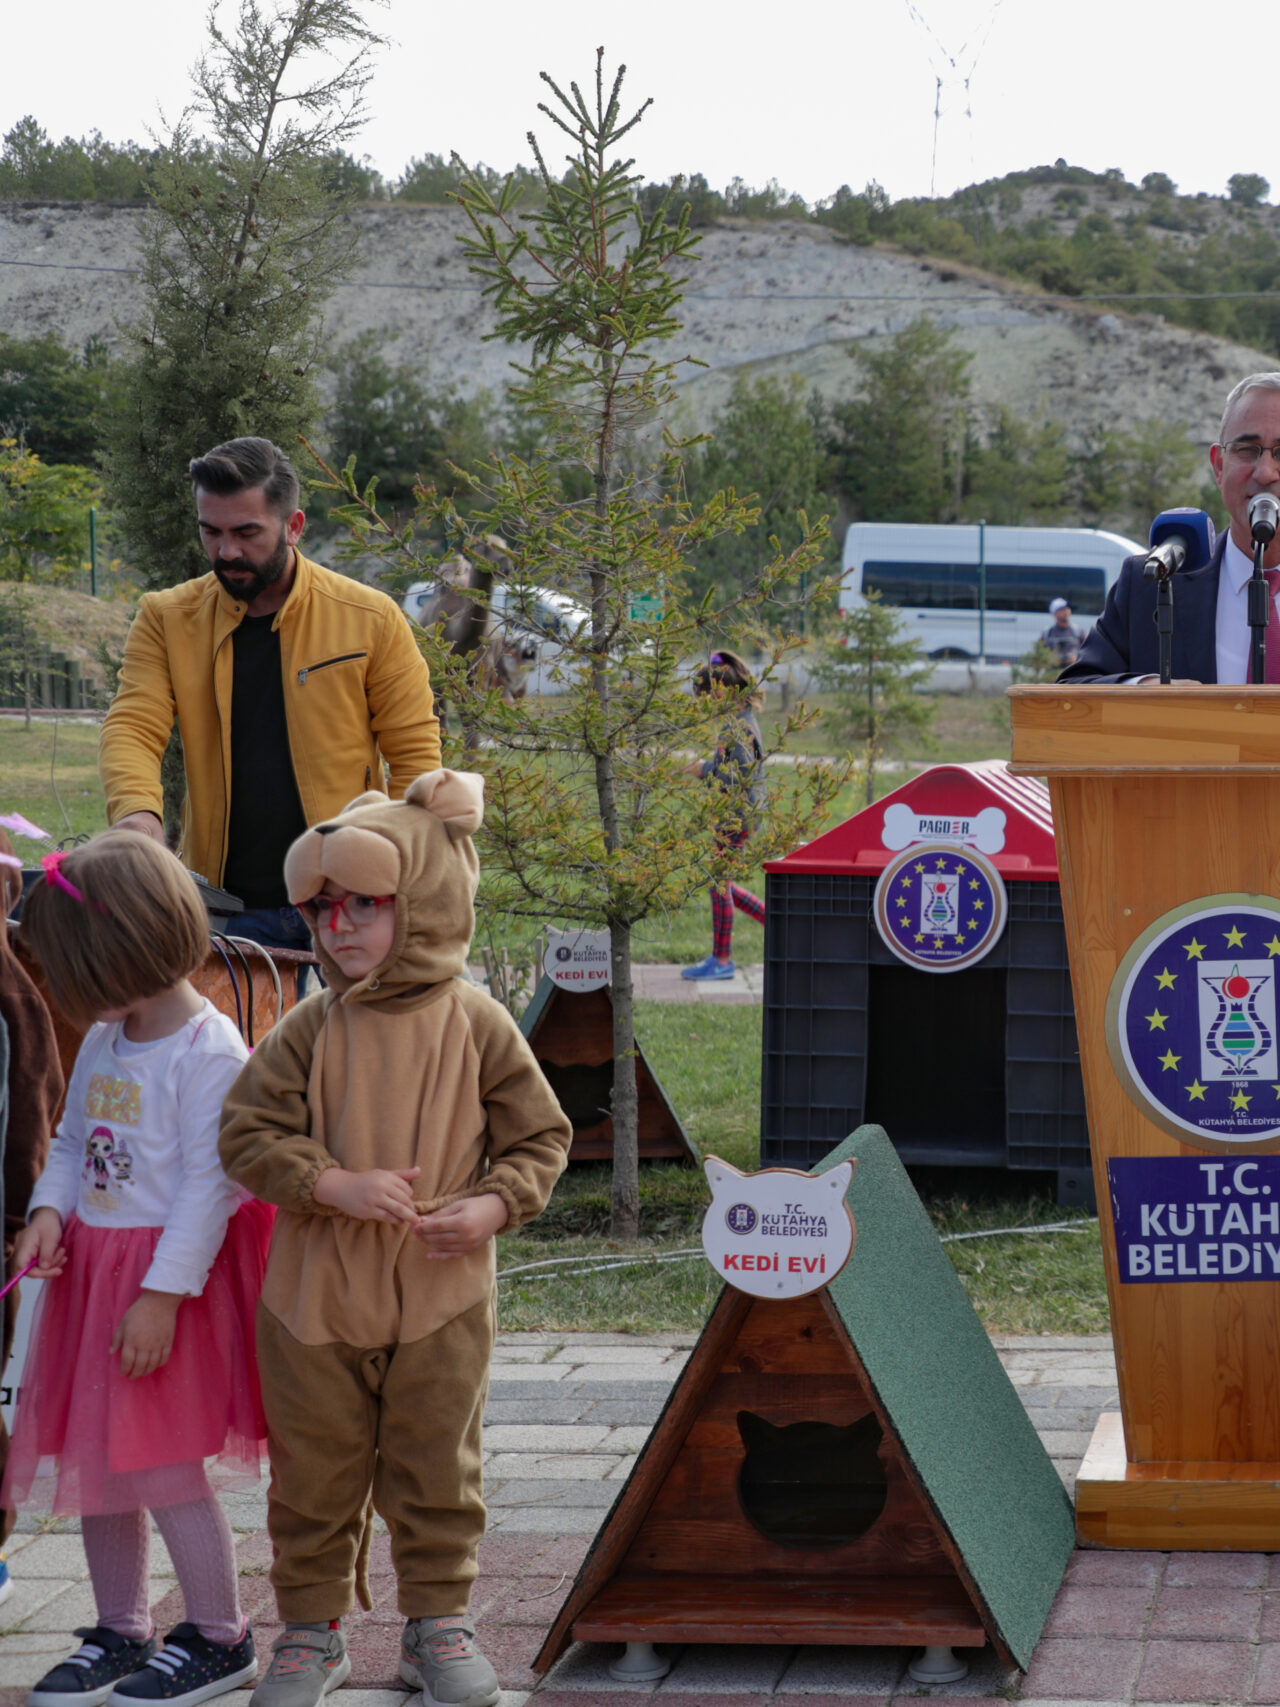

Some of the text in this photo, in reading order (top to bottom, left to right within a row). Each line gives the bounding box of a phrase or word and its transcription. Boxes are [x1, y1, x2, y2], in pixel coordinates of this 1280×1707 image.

[919, 820, 970, 834] PAGDER
[556, 968, 608, 980] KEDİ EVİ
[1199, 1117, 1235, 1126] KÜTAHYA
[1200, 1163, 1271, 1196] T.C.
[784, 1203, 806, 1215] T.C.
[761, 1214, 827, 1226] KÜTAHYA
[761, 1226, 828, 1238] BELEDİYESİ
[723, 1252, 826, 1274] KEDİ EVİ
